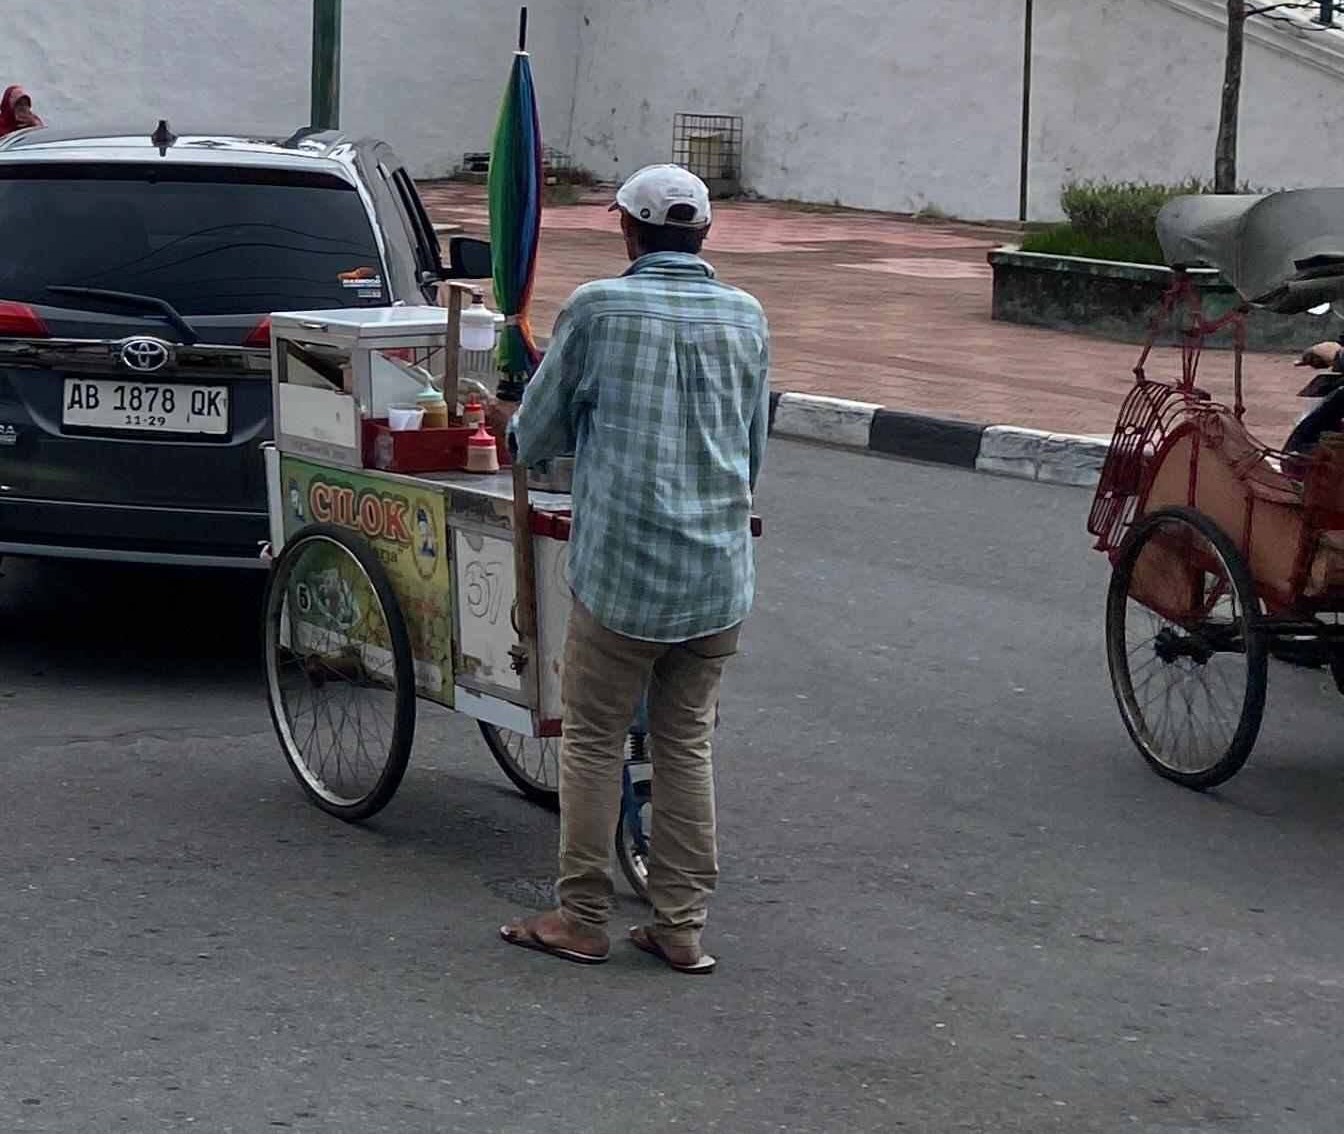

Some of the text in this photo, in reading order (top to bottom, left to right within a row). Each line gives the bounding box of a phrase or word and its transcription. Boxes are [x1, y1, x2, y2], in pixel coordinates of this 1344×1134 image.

[67, 383, 222, 417] AB 1878 QK
[310, 481, 411, 544] CILOK
[465, 560, 506, 626] 37
